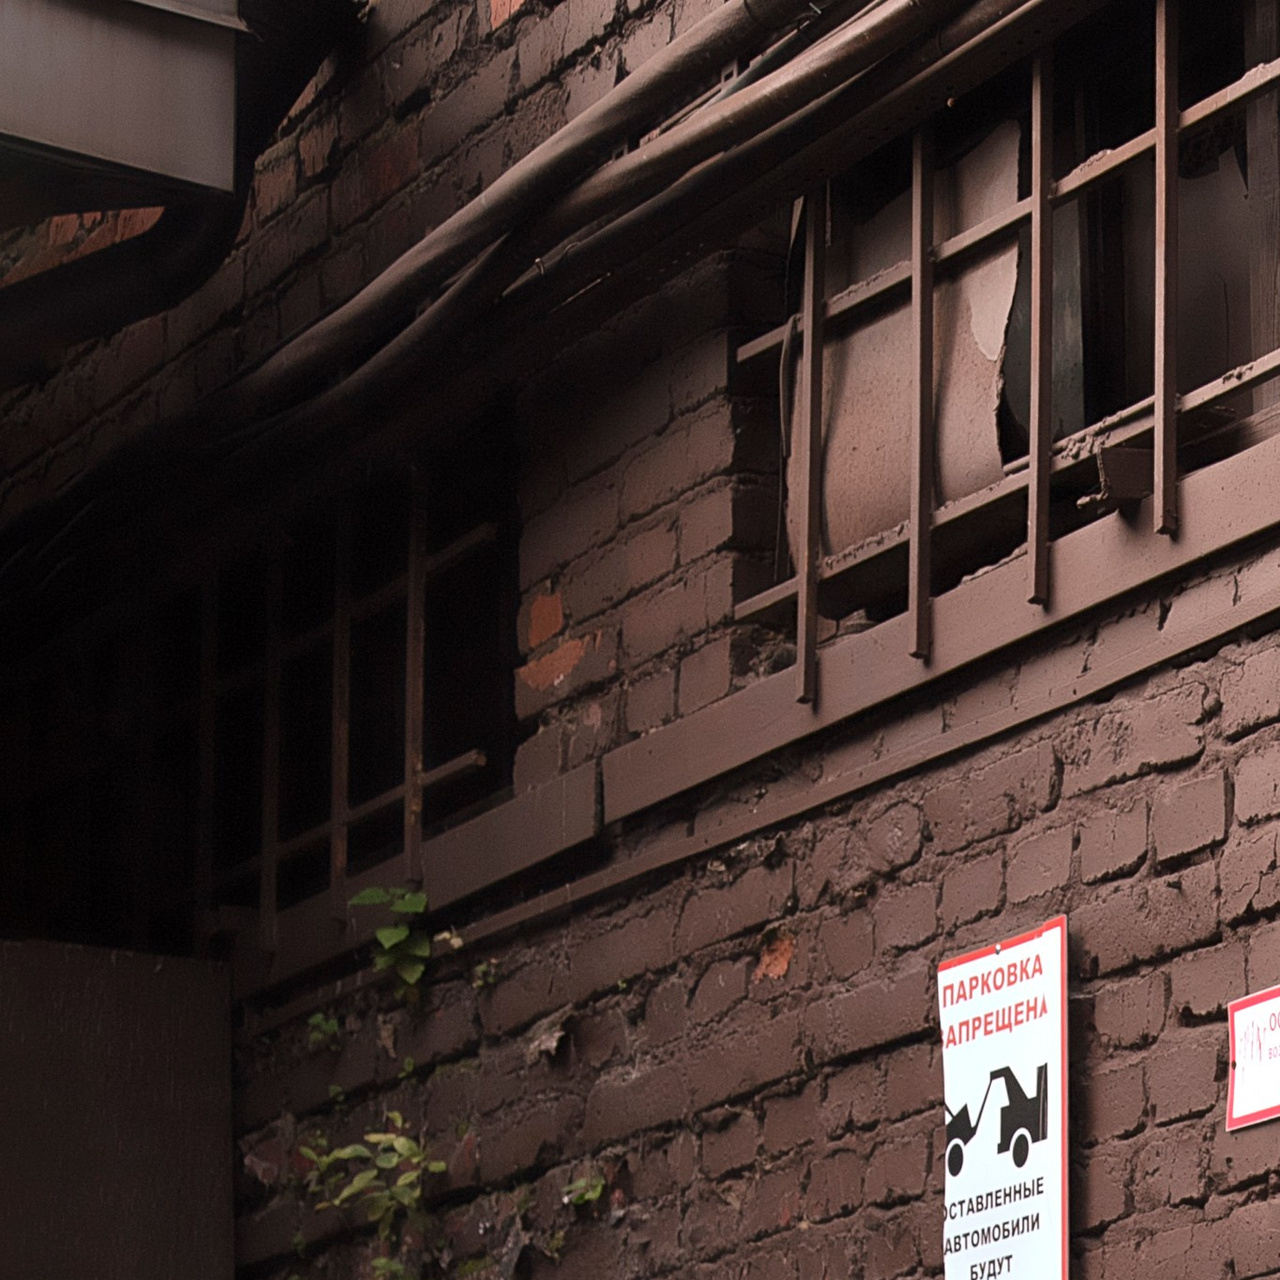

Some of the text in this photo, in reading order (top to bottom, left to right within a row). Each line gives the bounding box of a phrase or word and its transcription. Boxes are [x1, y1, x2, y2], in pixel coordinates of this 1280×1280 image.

[942, 953, 1043, 1008] ПАРКОВКА
[941, 993, 1048, 1050] АПРЕЩЕНА
[944, 1212, 1041, 1256] АВТОМОБИЛИ
